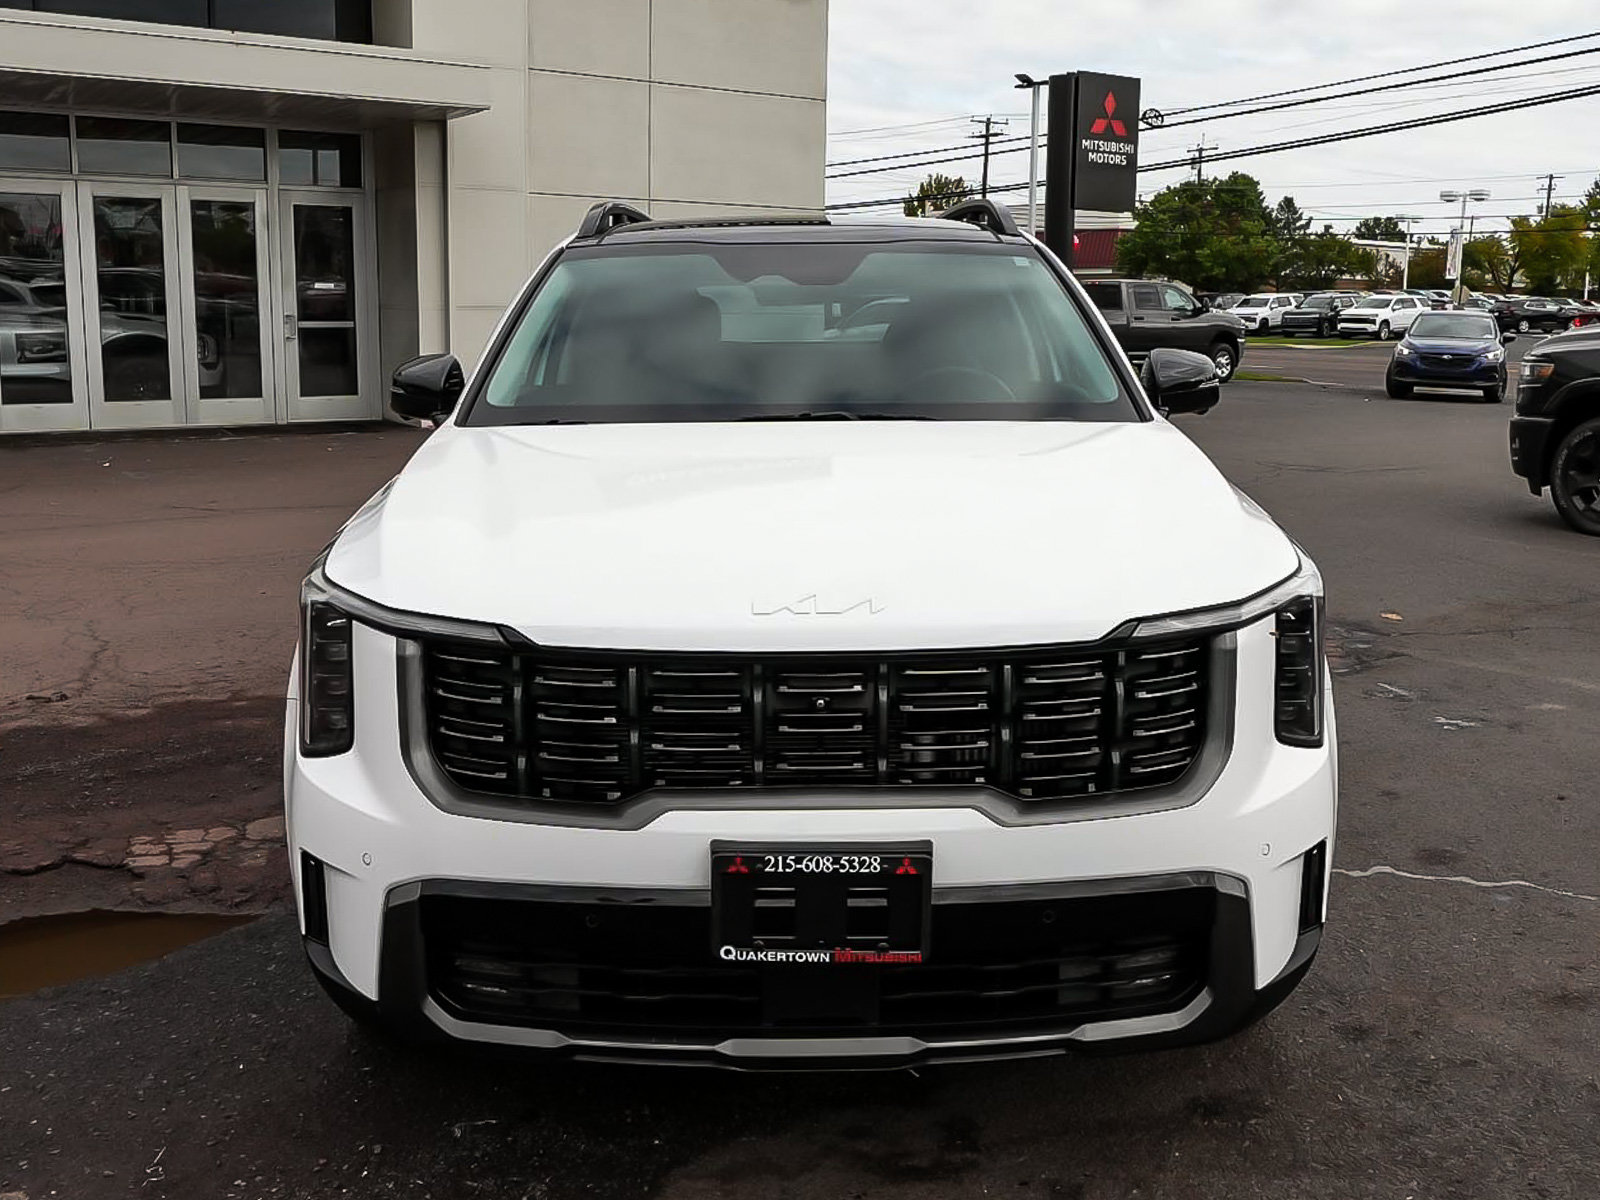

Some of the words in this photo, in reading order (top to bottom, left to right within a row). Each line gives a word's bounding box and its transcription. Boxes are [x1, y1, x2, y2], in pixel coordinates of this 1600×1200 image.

[1081, 139, 1134, 154] MITSUBISHI
[1088, 152, 1127, 165] MOTORS
[764, 855, 881, 873] 215-608-5328
[719, 945, 831, 963] QUAKERTOWN
[834, 947, 923, 963] MITSUBISHI
